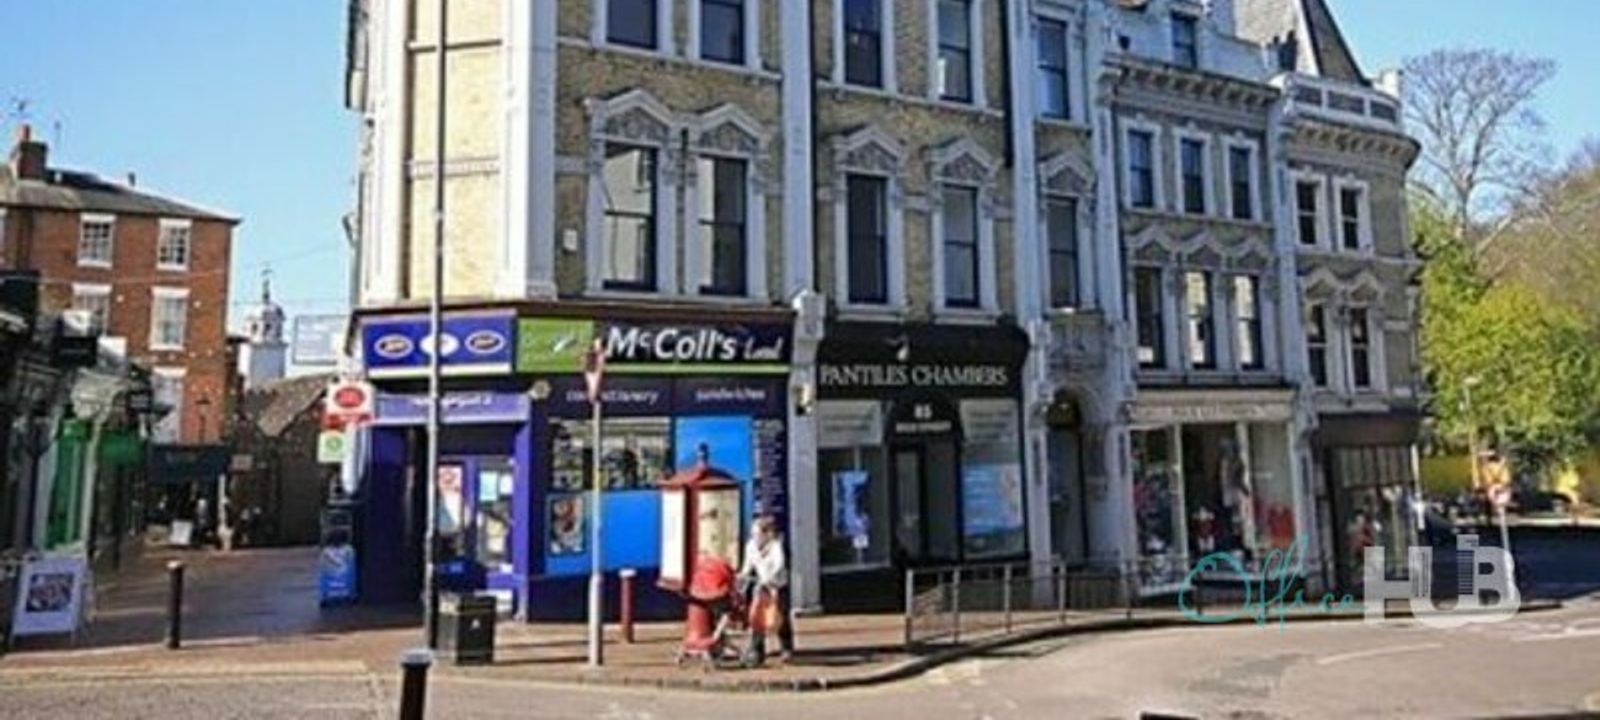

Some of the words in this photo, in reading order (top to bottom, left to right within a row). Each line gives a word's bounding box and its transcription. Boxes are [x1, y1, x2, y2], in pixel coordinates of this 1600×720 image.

[606, 326, 737, 360] McColl's
[819, 364, 907, 386] PANTILES
[911, 365, 1008, 386] CHAMBERS
